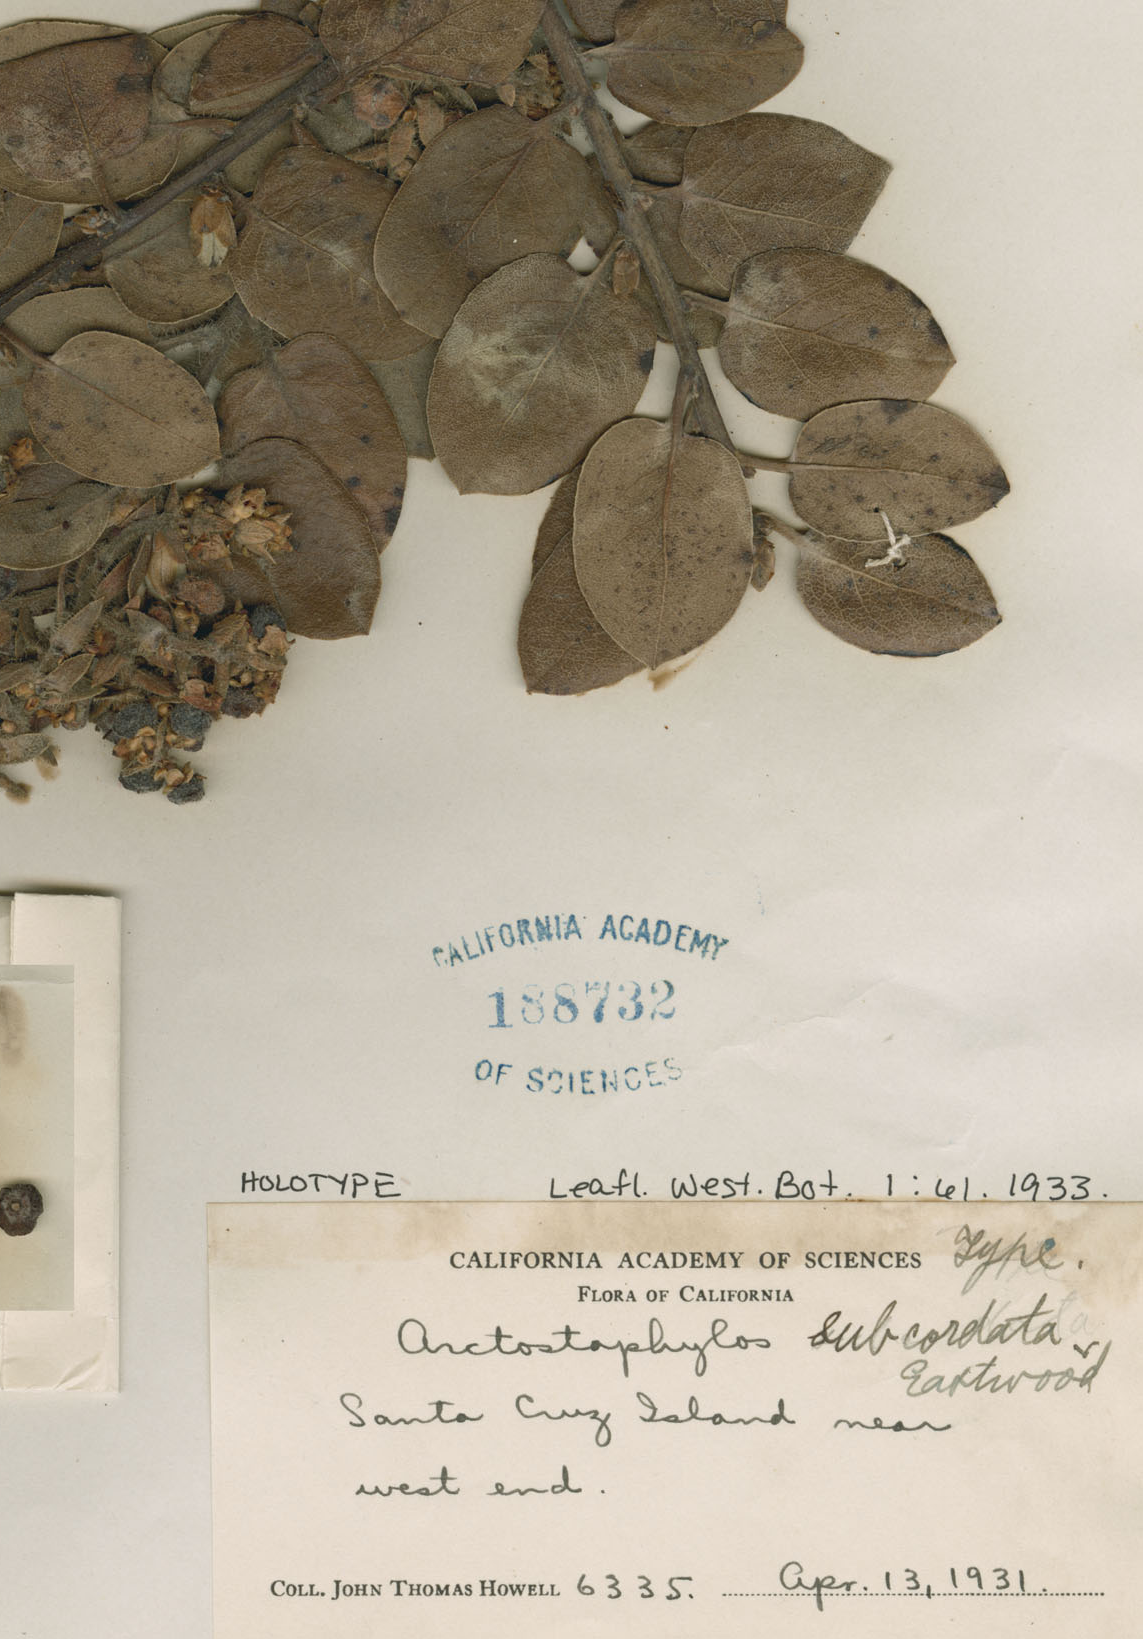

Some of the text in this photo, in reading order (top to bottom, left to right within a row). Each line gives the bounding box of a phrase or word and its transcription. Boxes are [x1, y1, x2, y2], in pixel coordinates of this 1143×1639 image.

[431, 913, 730, 967] CALIFORNIA ACADEMY
[487, 979, 676, 1029] 188732
[474, 1057, 683, 1095] OF SCIENCES
[241, 1171, 402, 1198] HOLOTYPE
[549, 1168, 649, 1200] Leafl.
[671, 1171, 763, 1198] West.
[775, 1169, 853, 1201] Bot.
[1008, 1172, 1109, 1200] 1933.
[449, 1250, 923, 1270] CALIFORNIA ACADEMY OF SCIENCES
[577, 1285, 638, 1303] FLORA
[679, 1285, 795, 1303] CALIFORNIA
[339, 1392, 485, 1428] Santa
[515, 1394, 612, 1448] Cruz
[635, 1391, 797, 1426] Island
[354, 1465, 461, 1496] west
[331, 1579, 382, 1600] JOHN
[390, 1579, 473, 1598] THOMAS
[479, 1579, 561, 1598] HOWELL
